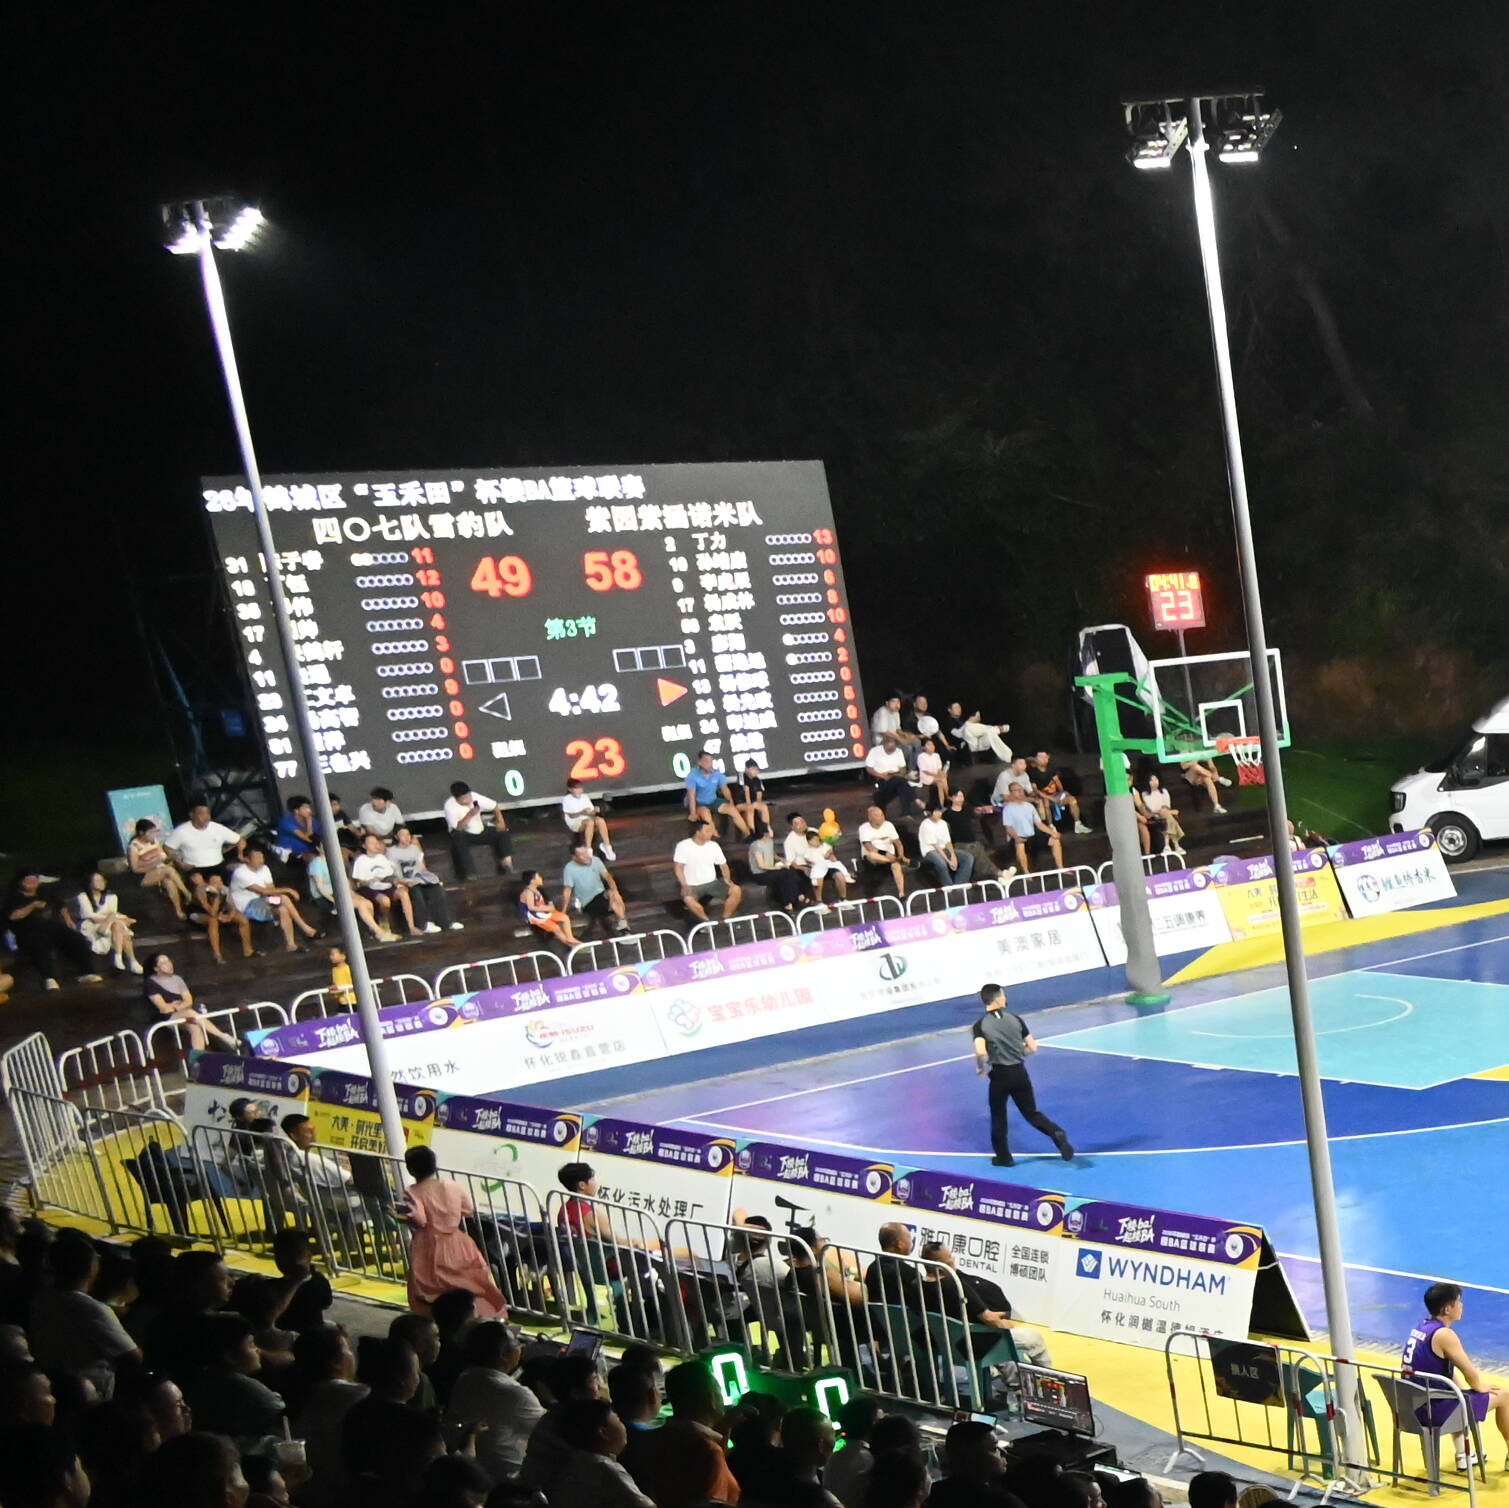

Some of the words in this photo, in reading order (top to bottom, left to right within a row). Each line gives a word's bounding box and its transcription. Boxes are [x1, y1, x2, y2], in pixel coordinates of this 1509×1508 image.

[692, 531, 727, 551] 丁力
[813, 528, 834, 546] 13
[411, 547, 435, 564] 11
[816, 548, 837, 565] 10
[225, 556, 249, 574] 31
[584, 550, 643, 592] 58
[416, 568, 441, 587] 12
[471, 555, 533, 598] 49
[421, 590, 446, 608] 10
[1160, 591, 1195, 622] 23
[430, 613, 446, 630] 4
[826, 607, 847, 624] 10
[242, 625, 264, 643] 17
[545, 616, 597, 640] 第3节
[833, 628, 847, 643] 4
[248, 649, 263, 666] 4
[837, 646, 849, 663] 2
[439, 657, 455, 674] 0
[688, 658, 707, 674] 11
[839, 666, 853, 683] 0
[252, 670, 277, 687] 11
[548, 683, 621, 716] 4:42
[449, 700, 465, 718] 0
[846, 704, 859, 720] 0
[454, 721, 470, 739] 0
[849, 724, 863, 740] 0
[459, 742, 475, 760] 0
[566, 737, 627, 780] 23
[853, 742, 865, 759] 0
[672, 752, 691, 778] 0
[504, 769, 525, 796] 0
[707, 986, 814, 1022] 宝宝乐幼儿园
[597, 1185, 703, 1219] 怀化污水处理厂
[1011, 1245, 1050, 1264] 全国连锁
[960, 1257, 998, 1273] DENTAL
[1010, 1264, 1048, 1282] 博硕团队
[1109, 1256, 1226, 1295] WYNDHAM
[1104, 1288, 1147, 1306] Huaihua
[1150, 1295, 1181, 1313] South
[1403, 1337, 1416, 1364] 3
